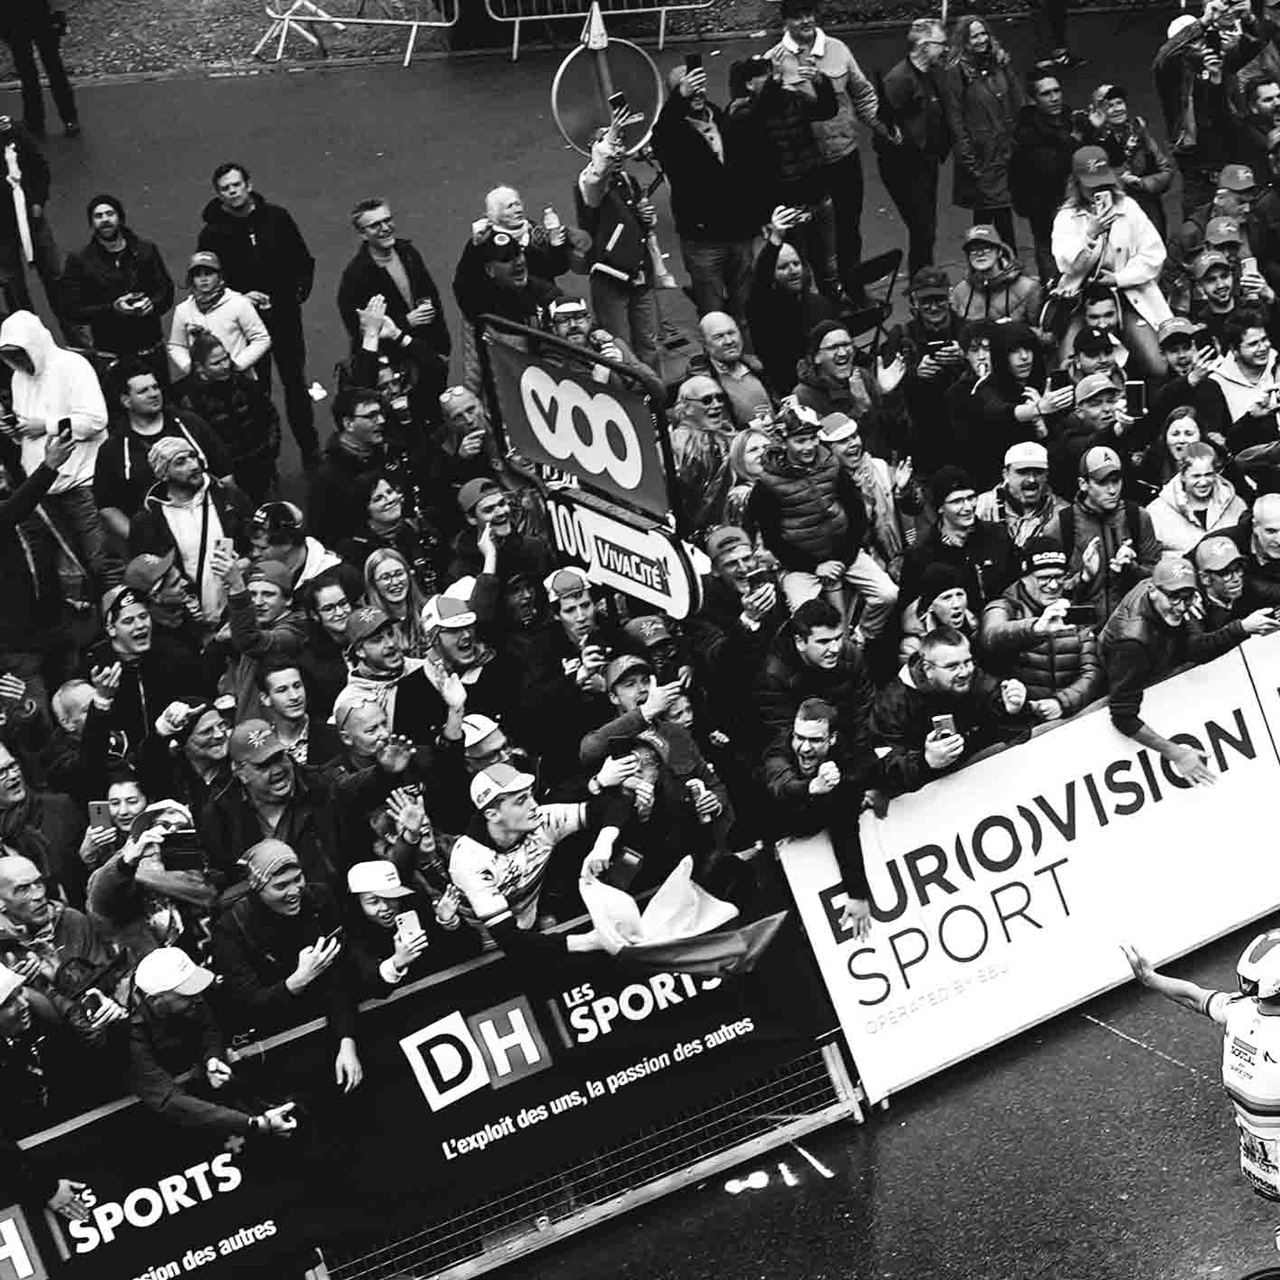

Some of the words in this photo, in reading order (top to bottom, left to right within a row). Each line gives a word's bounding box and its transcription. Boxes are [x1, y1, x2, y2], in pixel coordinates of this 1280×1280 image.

[546, 500, 591, 563] 100
[847, 858, 1070, 1006] SPORT
[563, 983, 595, 1008] LES
[416, 1008, 541, 1097] DH
[442, 1117, 516, 1160] L'exploit
[517, 1102, 549, 1128] des
[551, 1089, 588, 1116] uns,
[586, 1080, 605, 1099] la
[607, 1051, 671, 1093] passion
[673, 1037, 703, 1062] des
[705, 1016, 754, 1049] autres
[69, 1153, 242, 1253] SPORTS
[182, 1243, 217, 1272] des
[218, 1219, 278, 1256] autres
